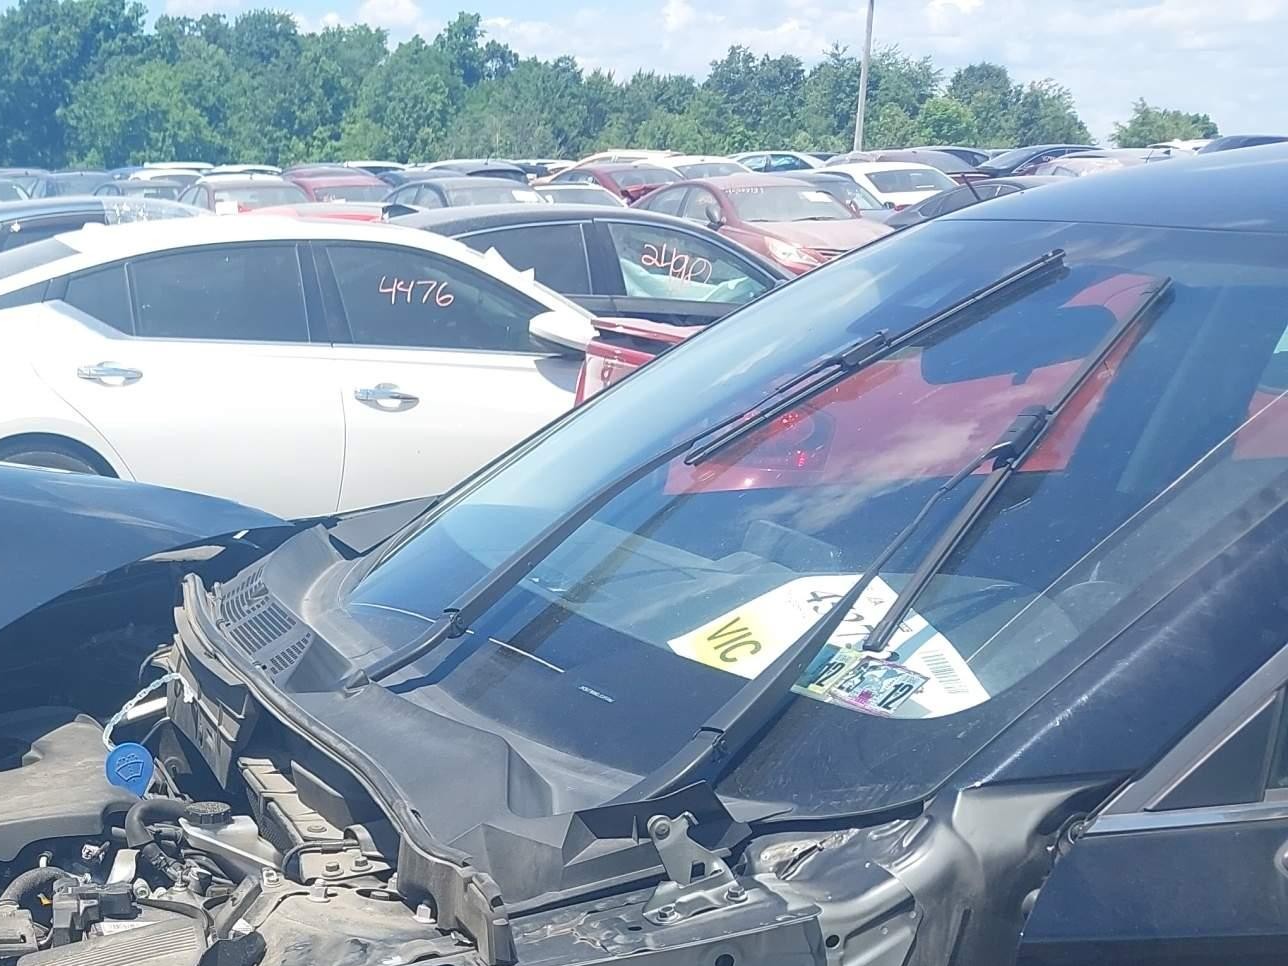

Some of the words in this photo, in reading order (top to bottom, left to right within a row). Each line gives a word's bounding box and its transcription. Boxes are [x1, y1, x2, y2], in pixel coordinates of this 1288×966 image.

[379, 275, 455, 307] 4476
[707, 617, 762, 662] VIC
[810, 661, 845, 687] 12
[877, 683, 914, 711] 12
